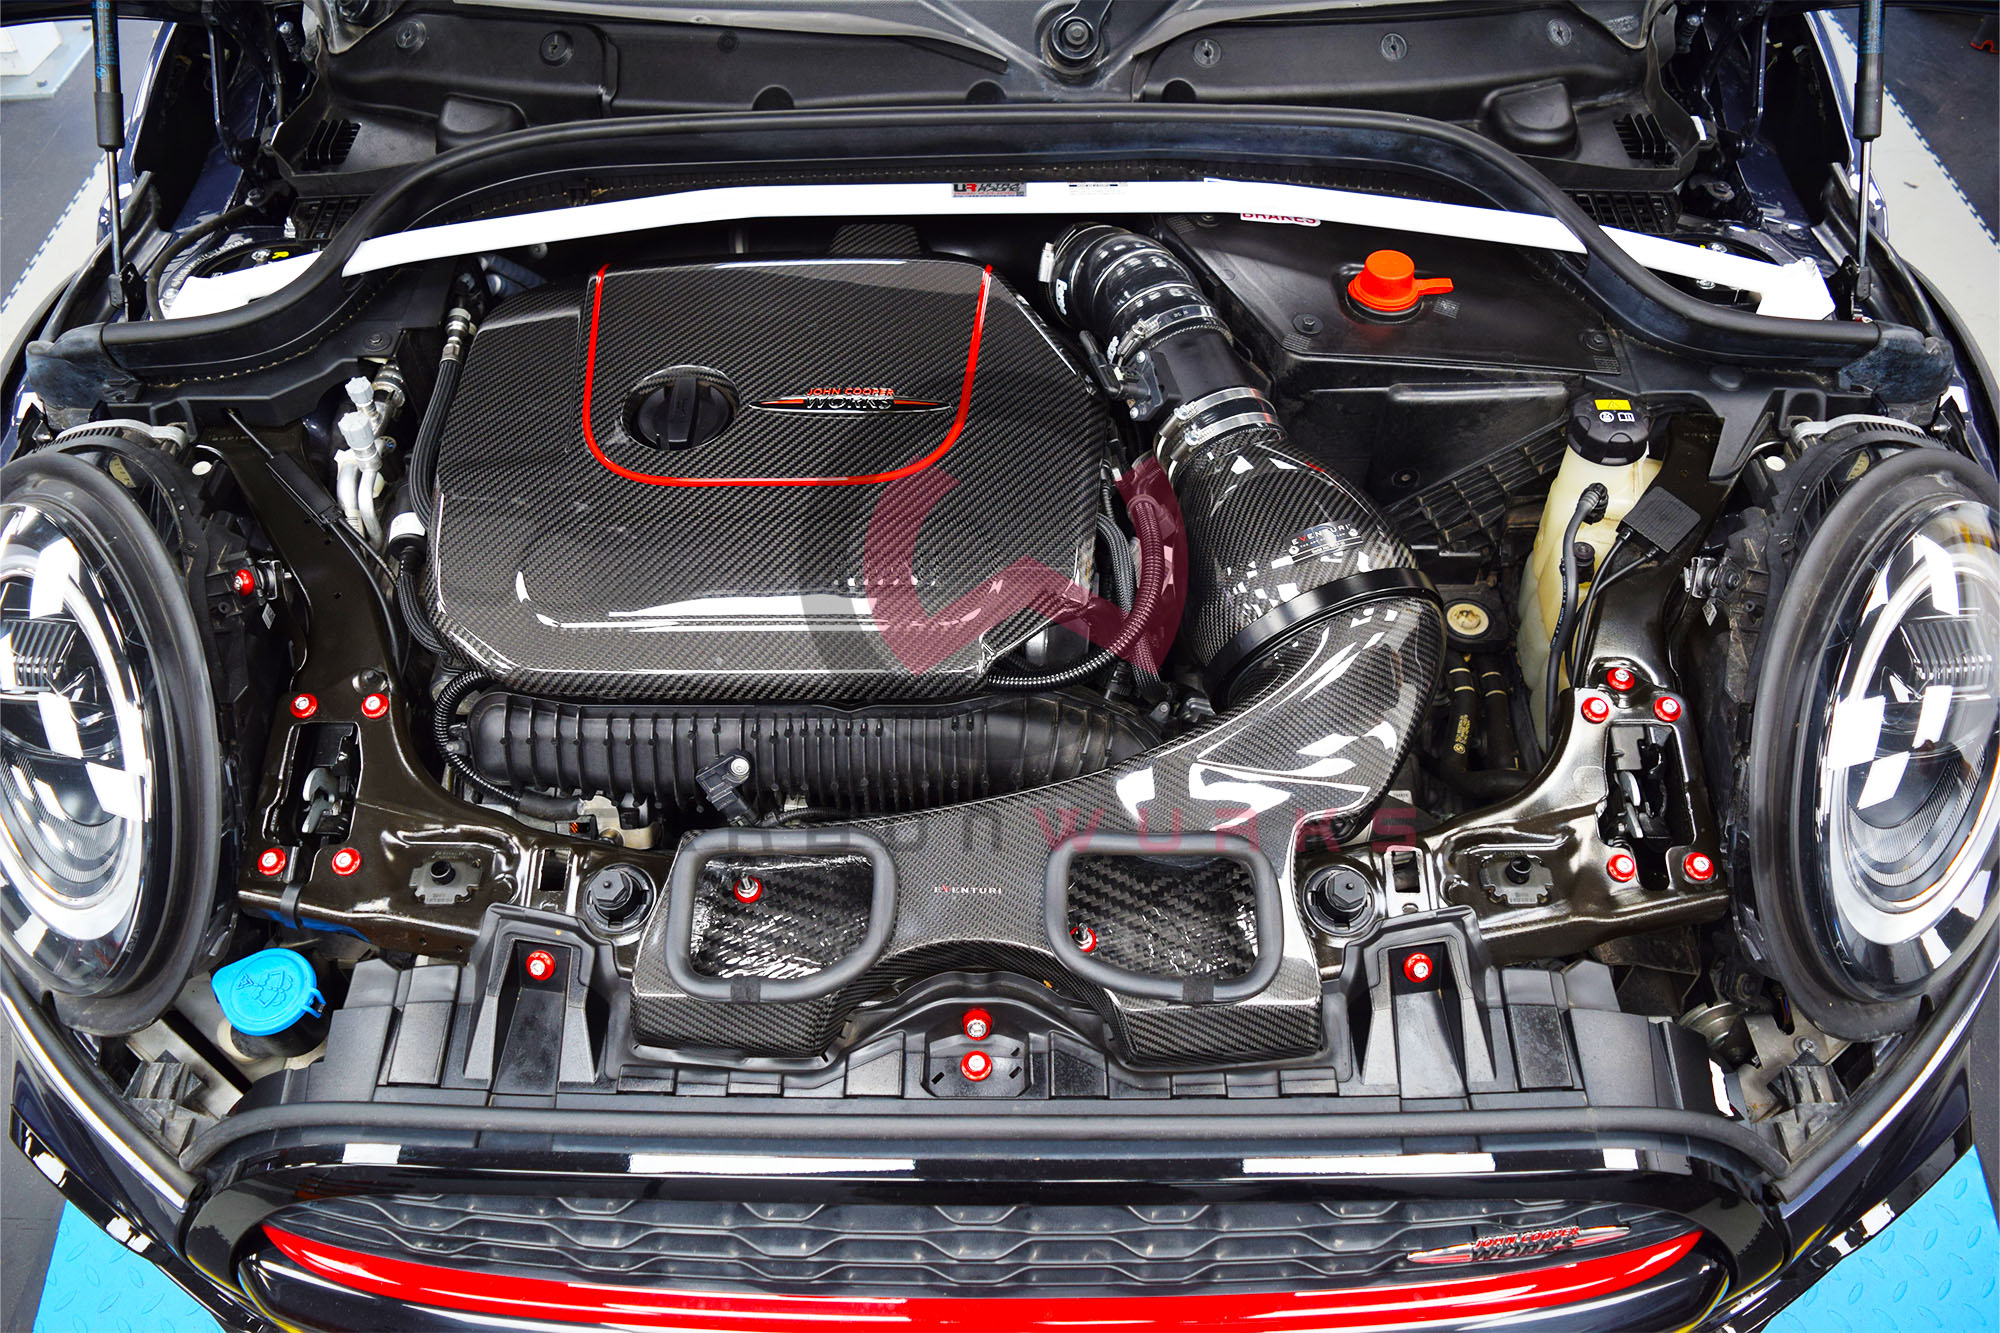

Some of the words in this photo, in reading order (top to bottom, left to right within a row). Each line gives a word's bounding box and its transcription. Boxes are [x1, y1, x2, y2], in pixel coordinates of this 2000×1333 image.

[805, 387, 841, 396] JOHN
[844, 386, 895, 397] COOPER
[806, 396, 892, 410] WORKS
[1291, 523, 1351, 546] EVENURI
[933, 884, 1003, 895] EVENTURI
[1475, 1235, 1519, 1249] JOHN
[1520, 1225, 1580, 1244] COOPER
